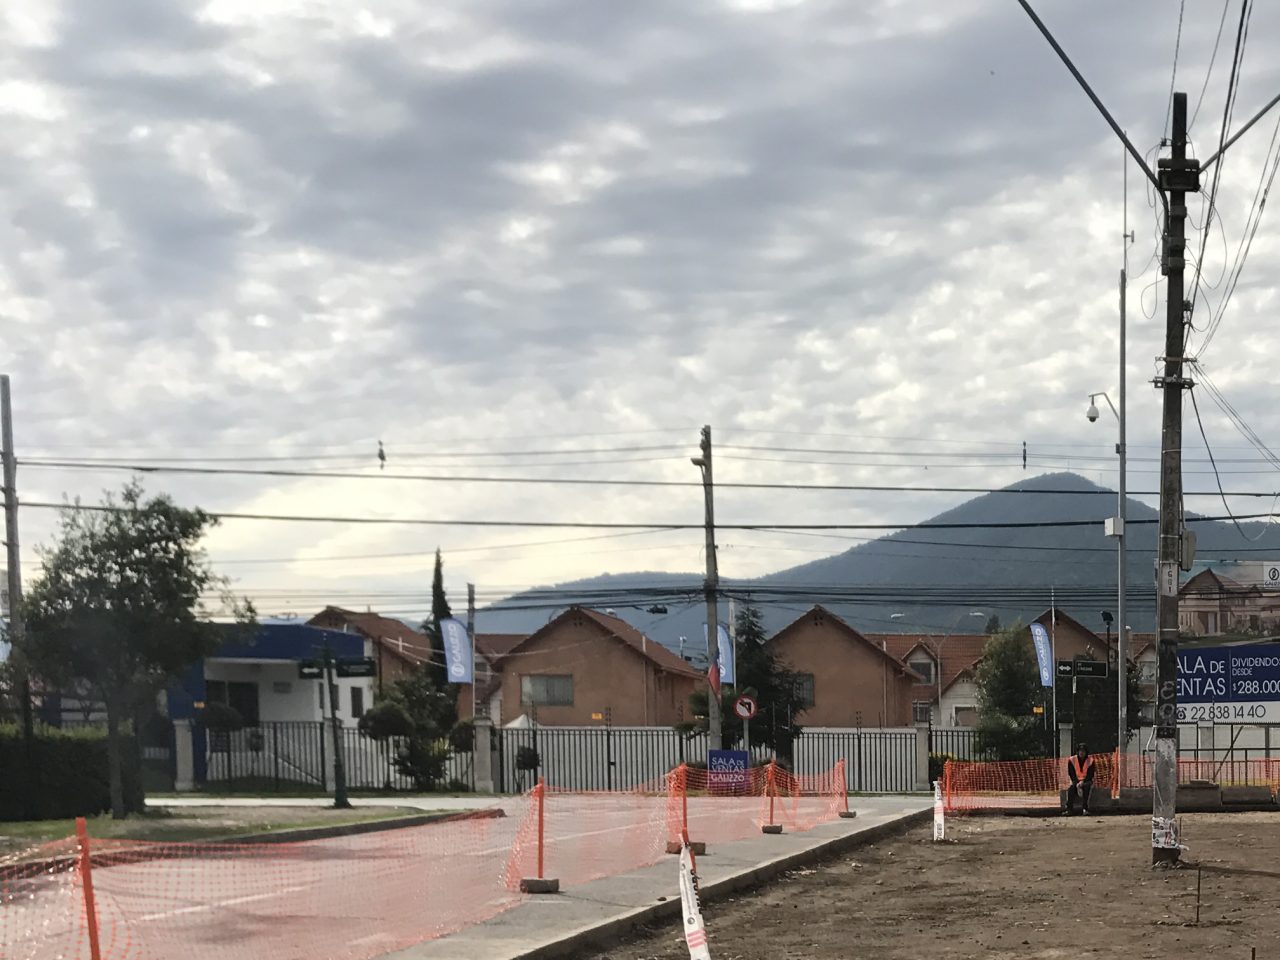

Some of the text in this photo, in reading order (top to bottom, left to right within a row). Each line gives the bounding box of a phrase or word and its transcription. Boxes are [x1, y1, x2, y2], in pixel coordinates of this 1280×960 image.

[1177, 656, 1225, 673] ALA DE
[1232, 668, 1253, 676] DESDE
[1177, 678, 1226, 695] ENTAS
[1191, 705, 1266, 720] 22 838 14 40
[712, 757, 735, 766] SALA
[712, 764, 745, 773] VENTAS
